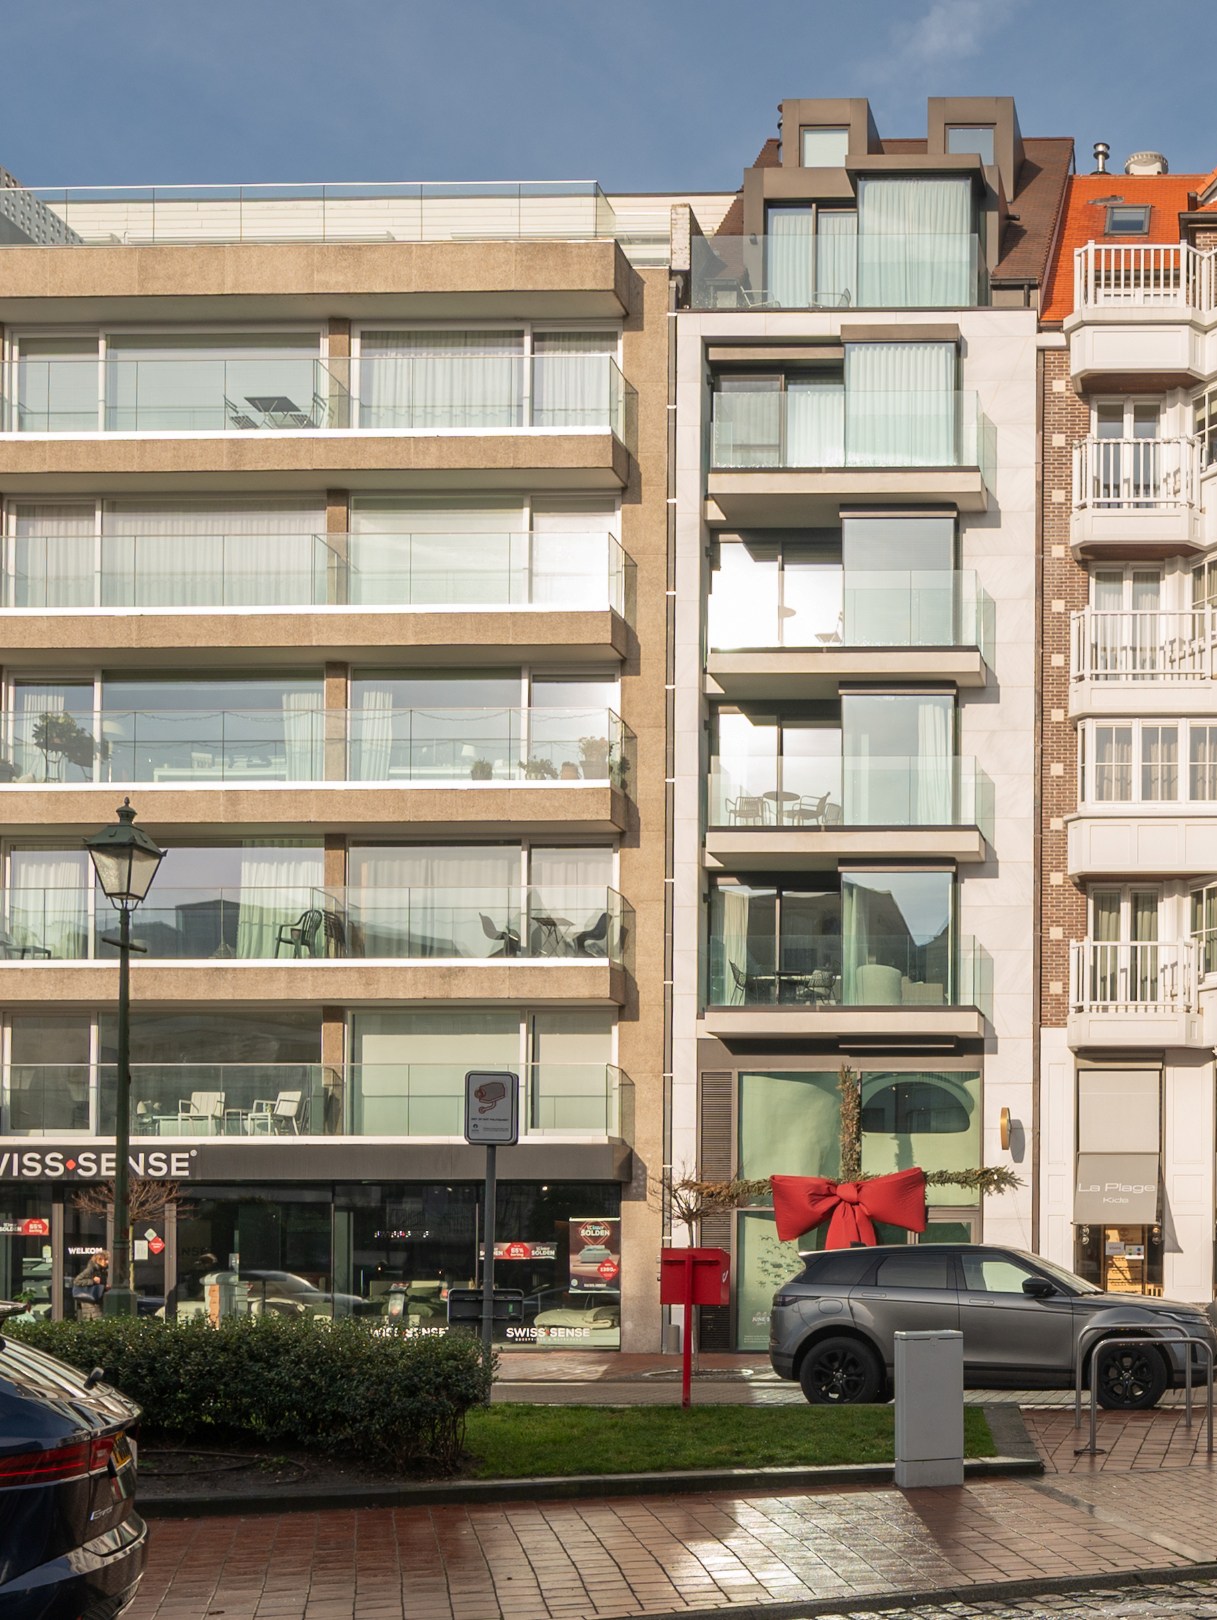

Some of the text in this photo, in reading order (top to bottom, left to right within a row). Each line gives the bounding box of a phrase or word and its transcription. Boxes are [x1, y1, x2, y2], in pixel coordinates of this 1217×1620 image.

[1078, 1183, 1156, 1194] La Plage
[1102, 1196, 1129, 1204] Kids
[506, 1327, 590, 1337] SWISS SENSE
